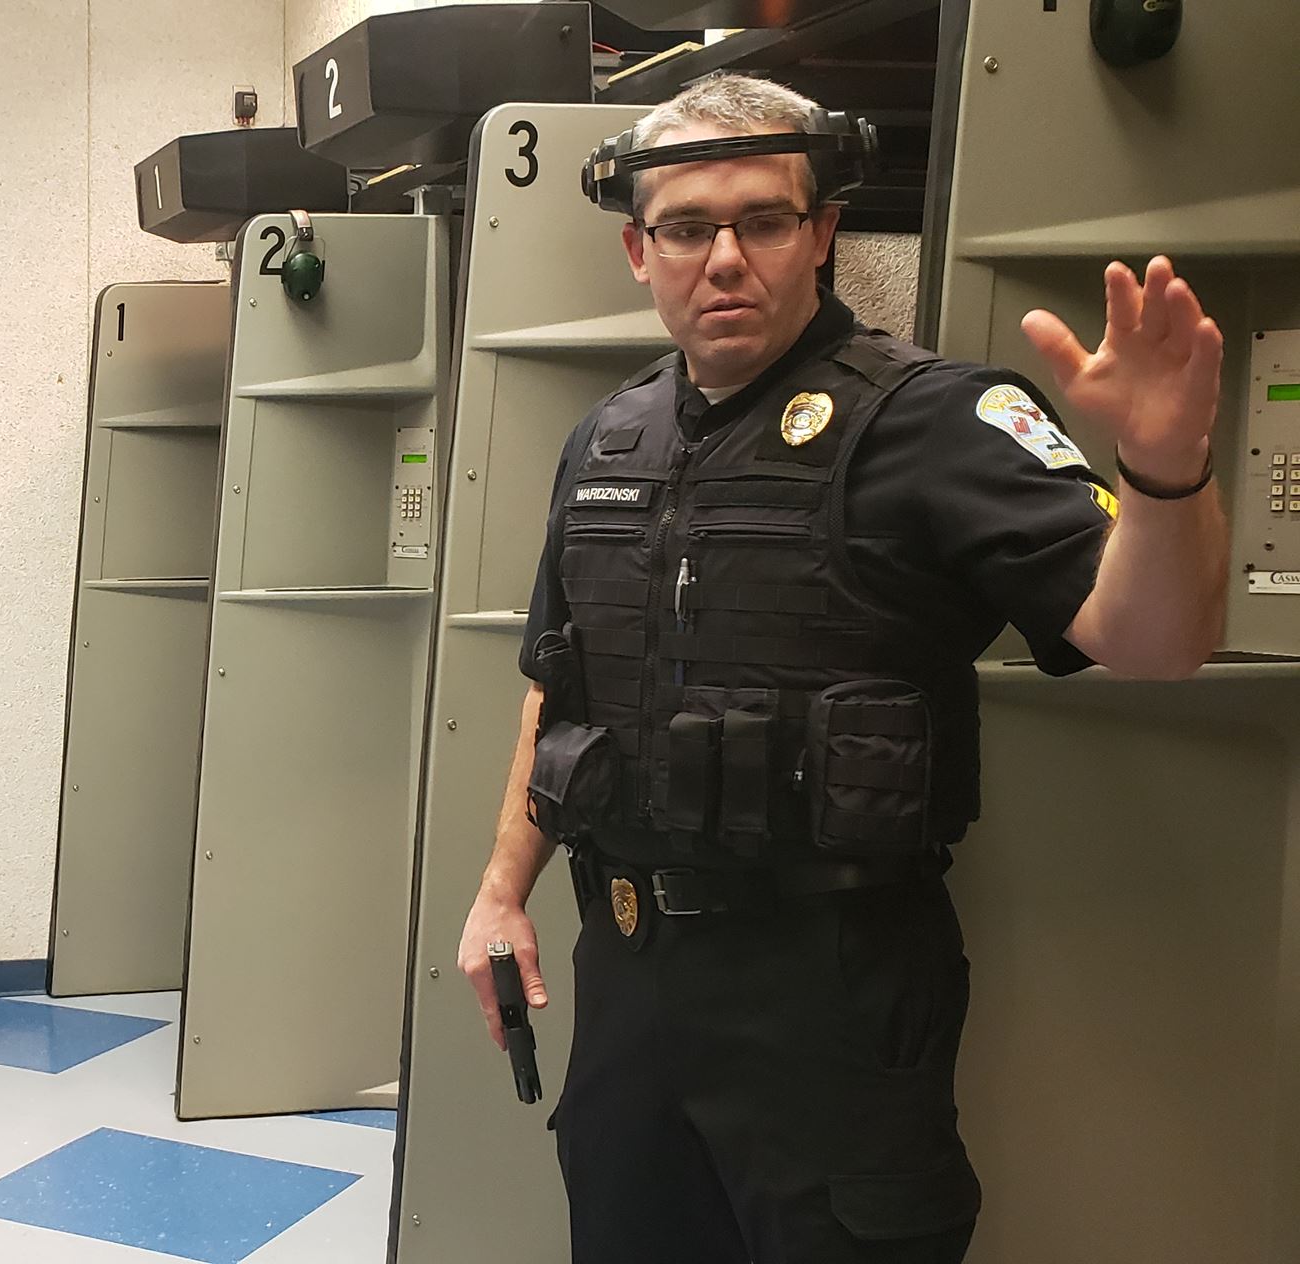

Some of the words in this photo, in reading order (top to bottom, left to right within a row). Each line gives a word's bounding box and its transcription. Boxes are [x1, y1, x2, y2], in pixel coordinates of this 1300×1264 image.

[325, 58, 343, 119] 2
[505, 120, 539, 187] 3
[153, 164, 163, 209] 1
[259, 225, 285, 275] 2
[117, 302, 125, 341] 1
[576, 487, 640, 502] WARDZINSKI
